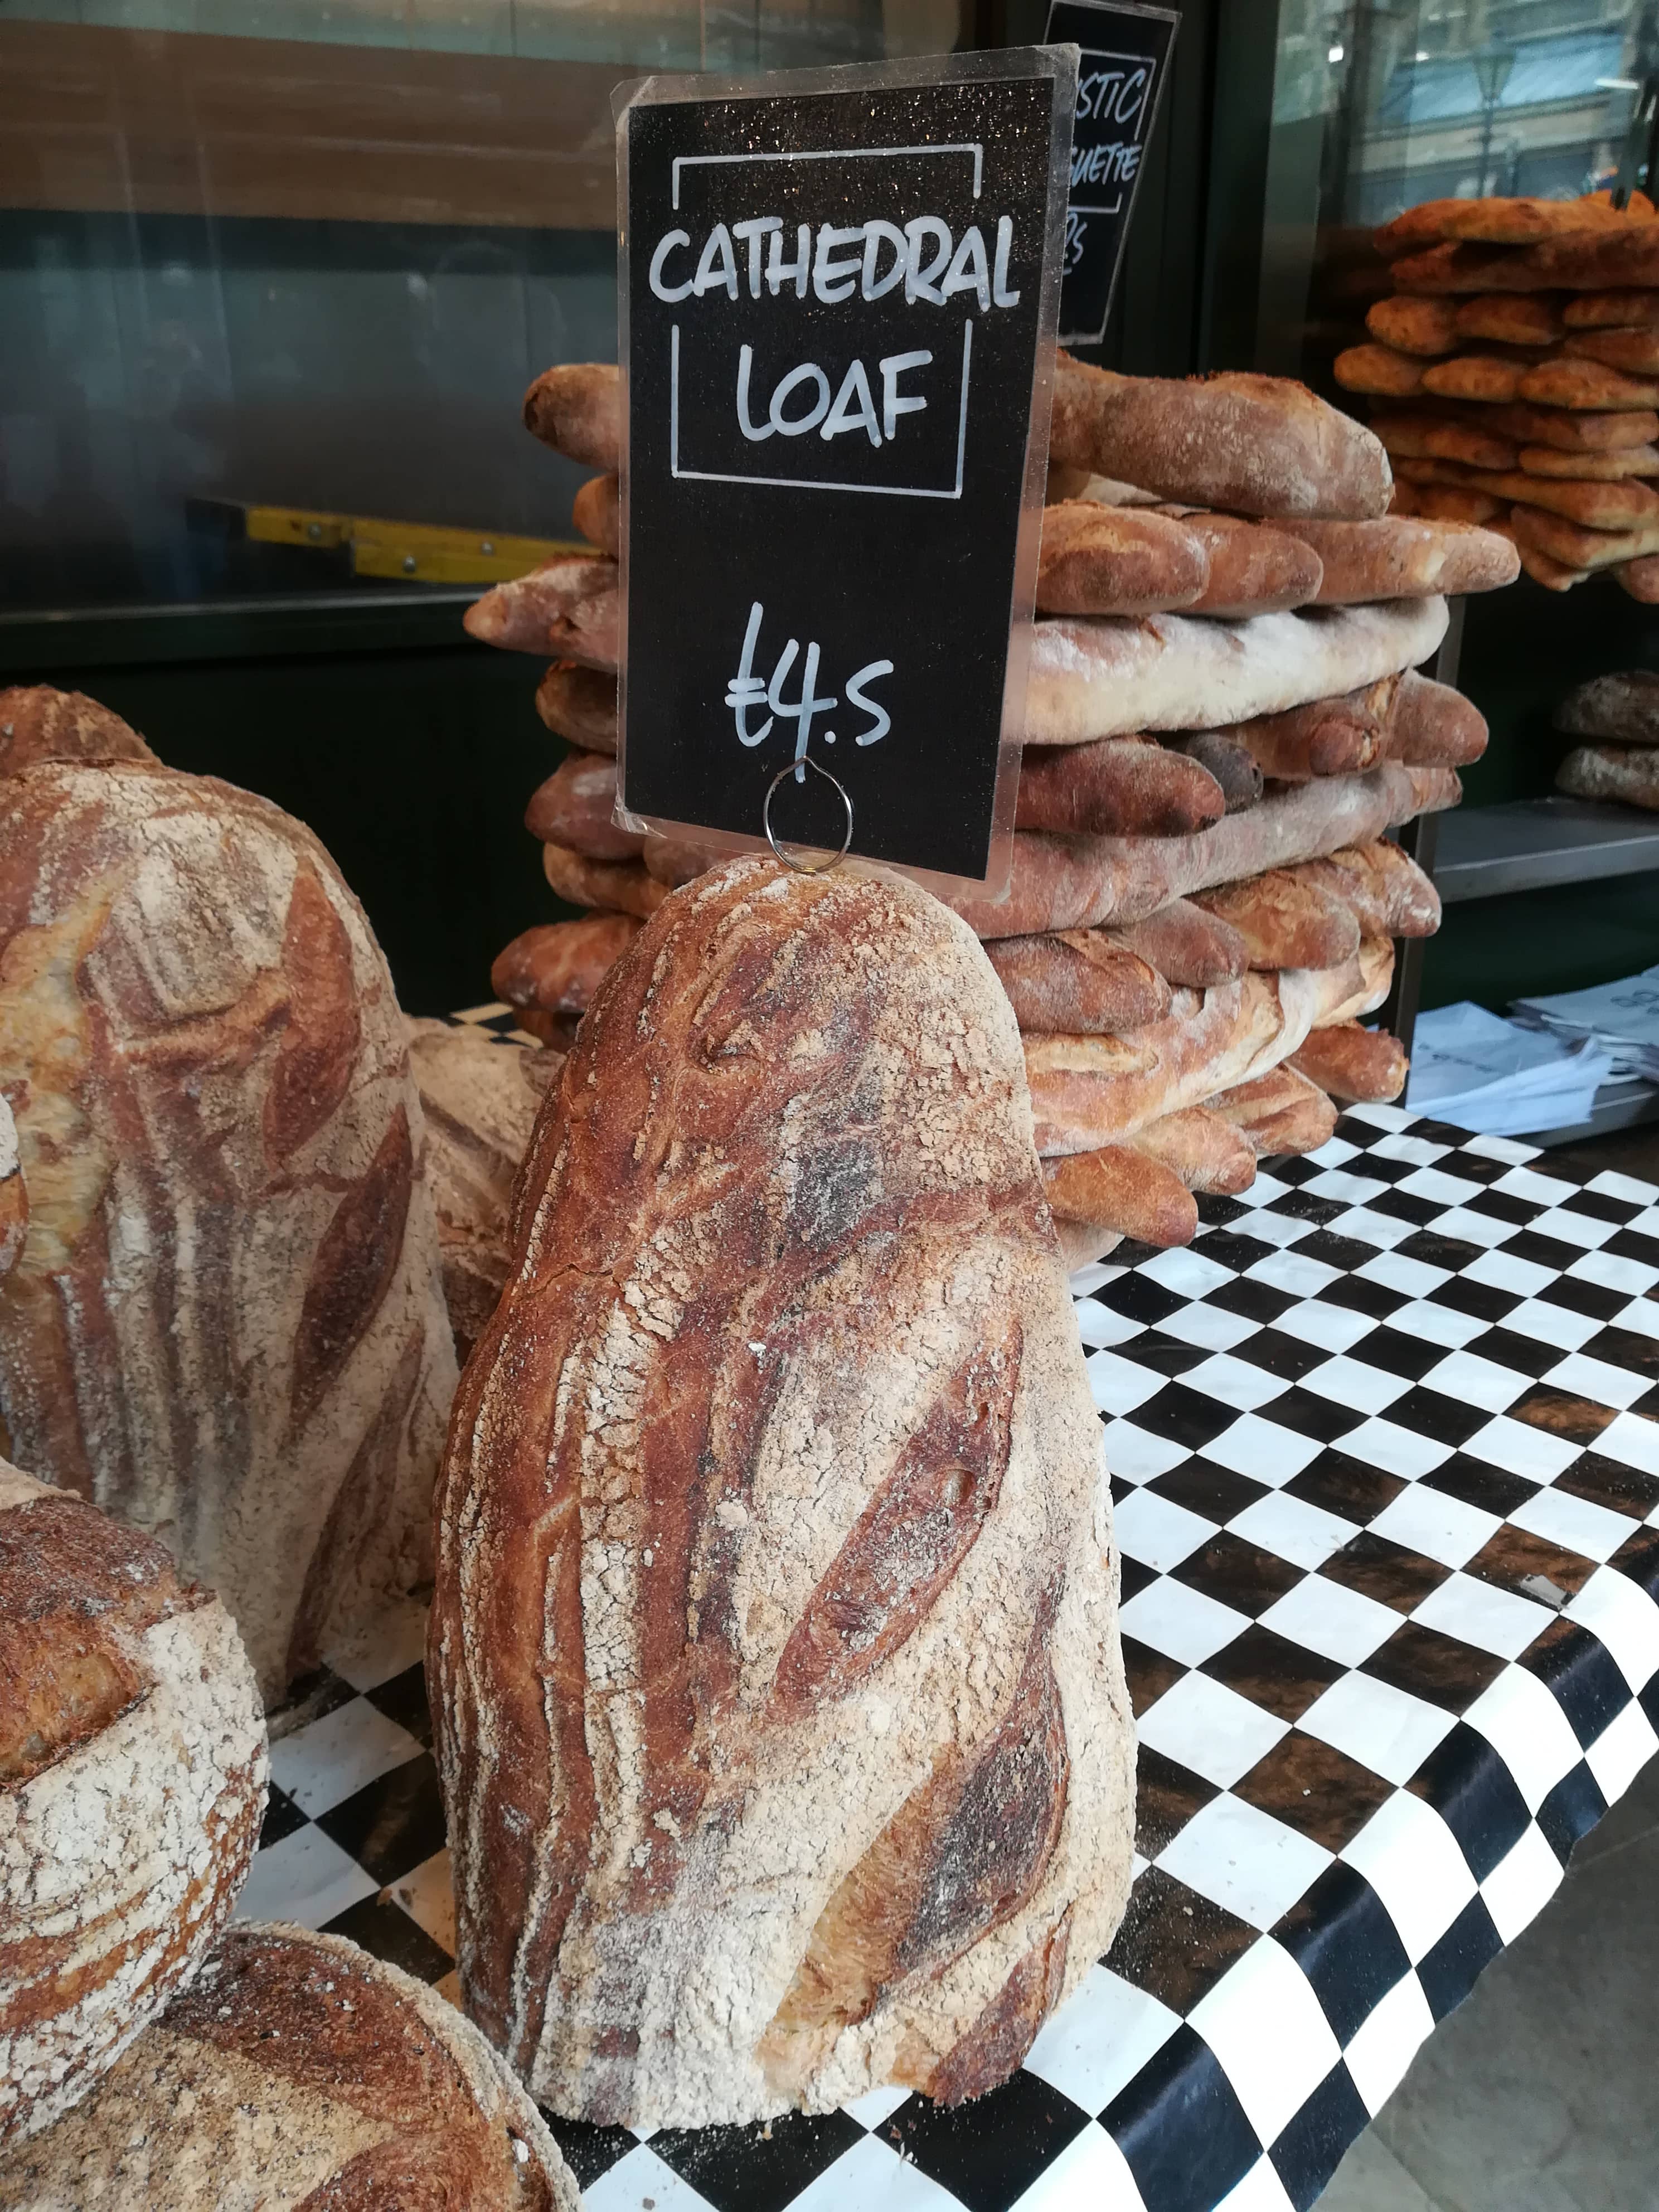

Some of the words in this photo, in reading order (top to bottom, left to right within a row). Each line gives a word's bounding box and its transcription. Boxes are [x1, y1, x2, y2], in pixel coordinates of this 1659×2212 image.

[1076, 67, 1147, 124] STIC
[649, 214, 1020, 313] CATHEDRAL
[735, 343, 934, 448] LOAF
